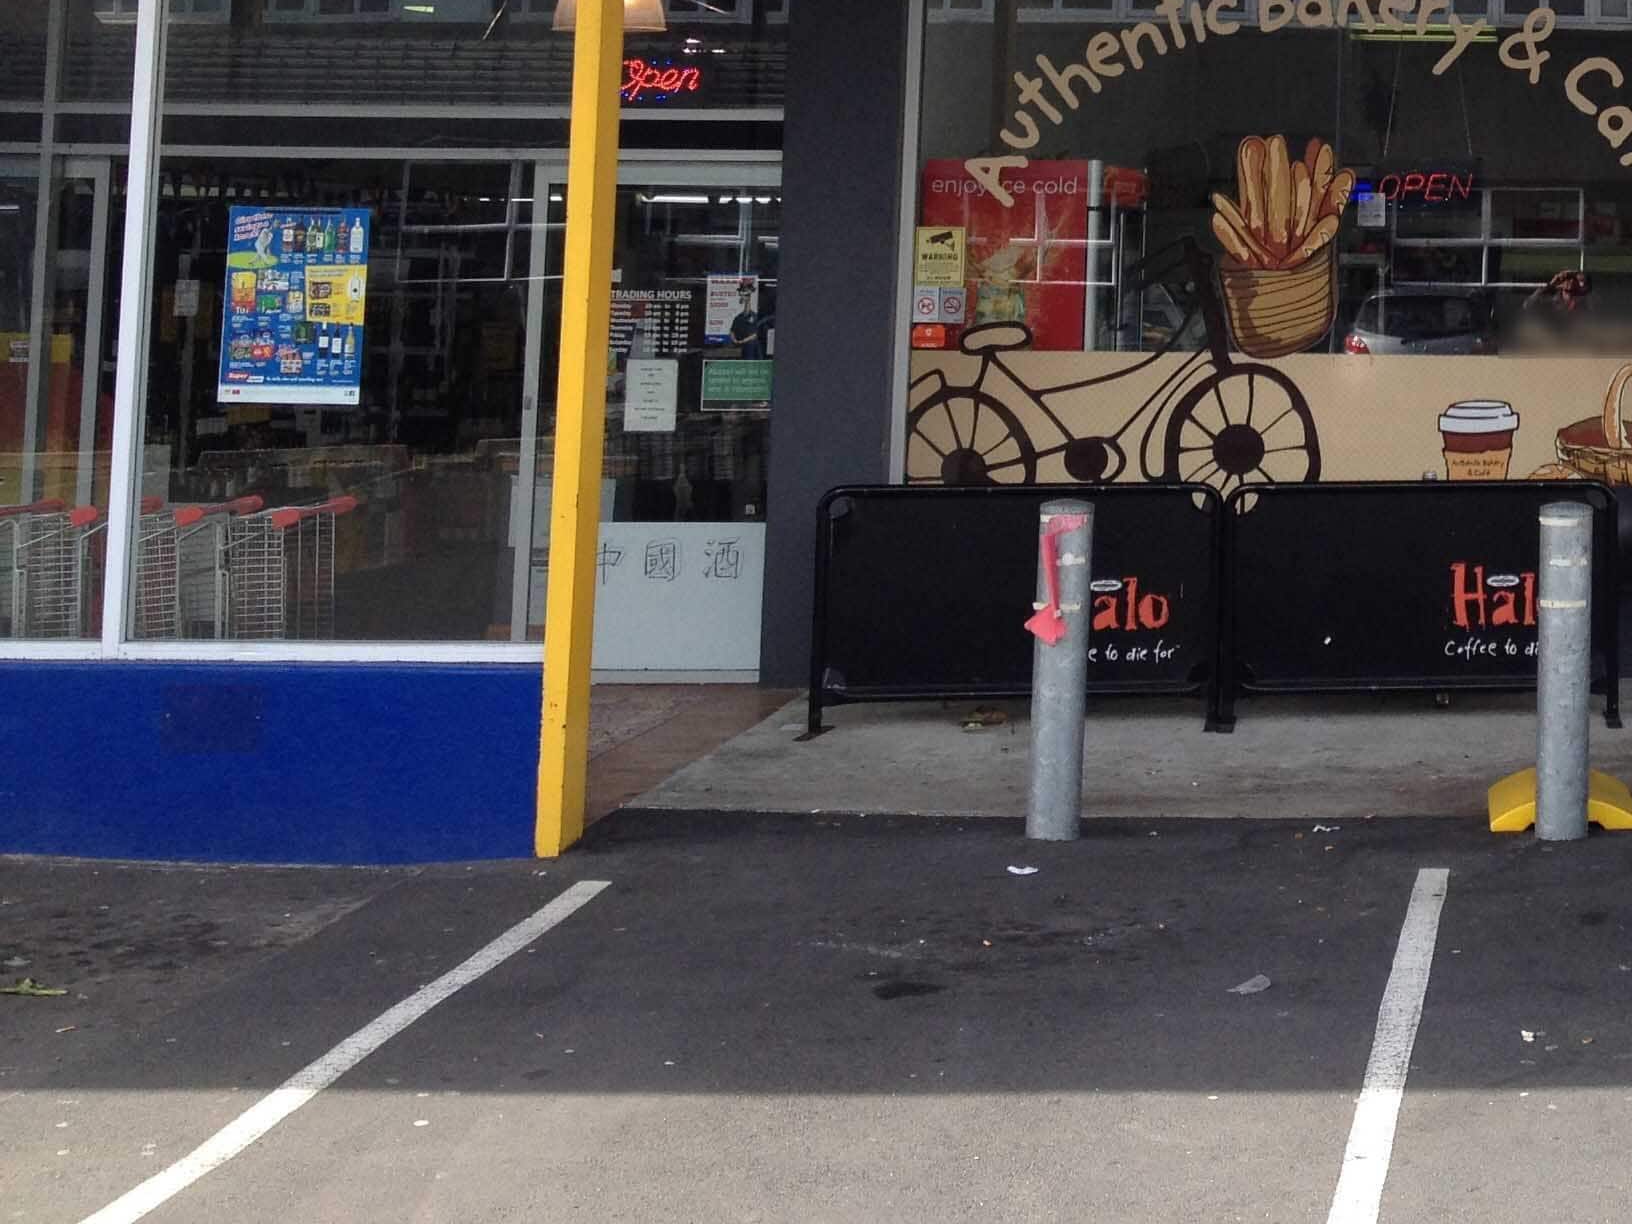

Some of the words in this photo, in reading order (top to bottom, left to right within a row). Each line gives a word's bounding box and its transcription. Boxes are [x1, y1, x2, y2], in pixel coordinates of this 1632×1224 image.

[1498, 6, 1556, 85] &
[1032, 176, 1078, 194] cold
[1378, 173, 1473, 200] OPEN
[657, 290, 693, 300] HOURS
[1092, 577, 1170, 631] alo
[1450, 562, 1539, 632] Hal
[1105, 643, 1120, 661] to
[1125, 647, 1149, 662] die
[1153, 639, 1175, 664] for
[1444, 637, 1498, 661] Coffee
[1504, 637, 1518, 656] to
